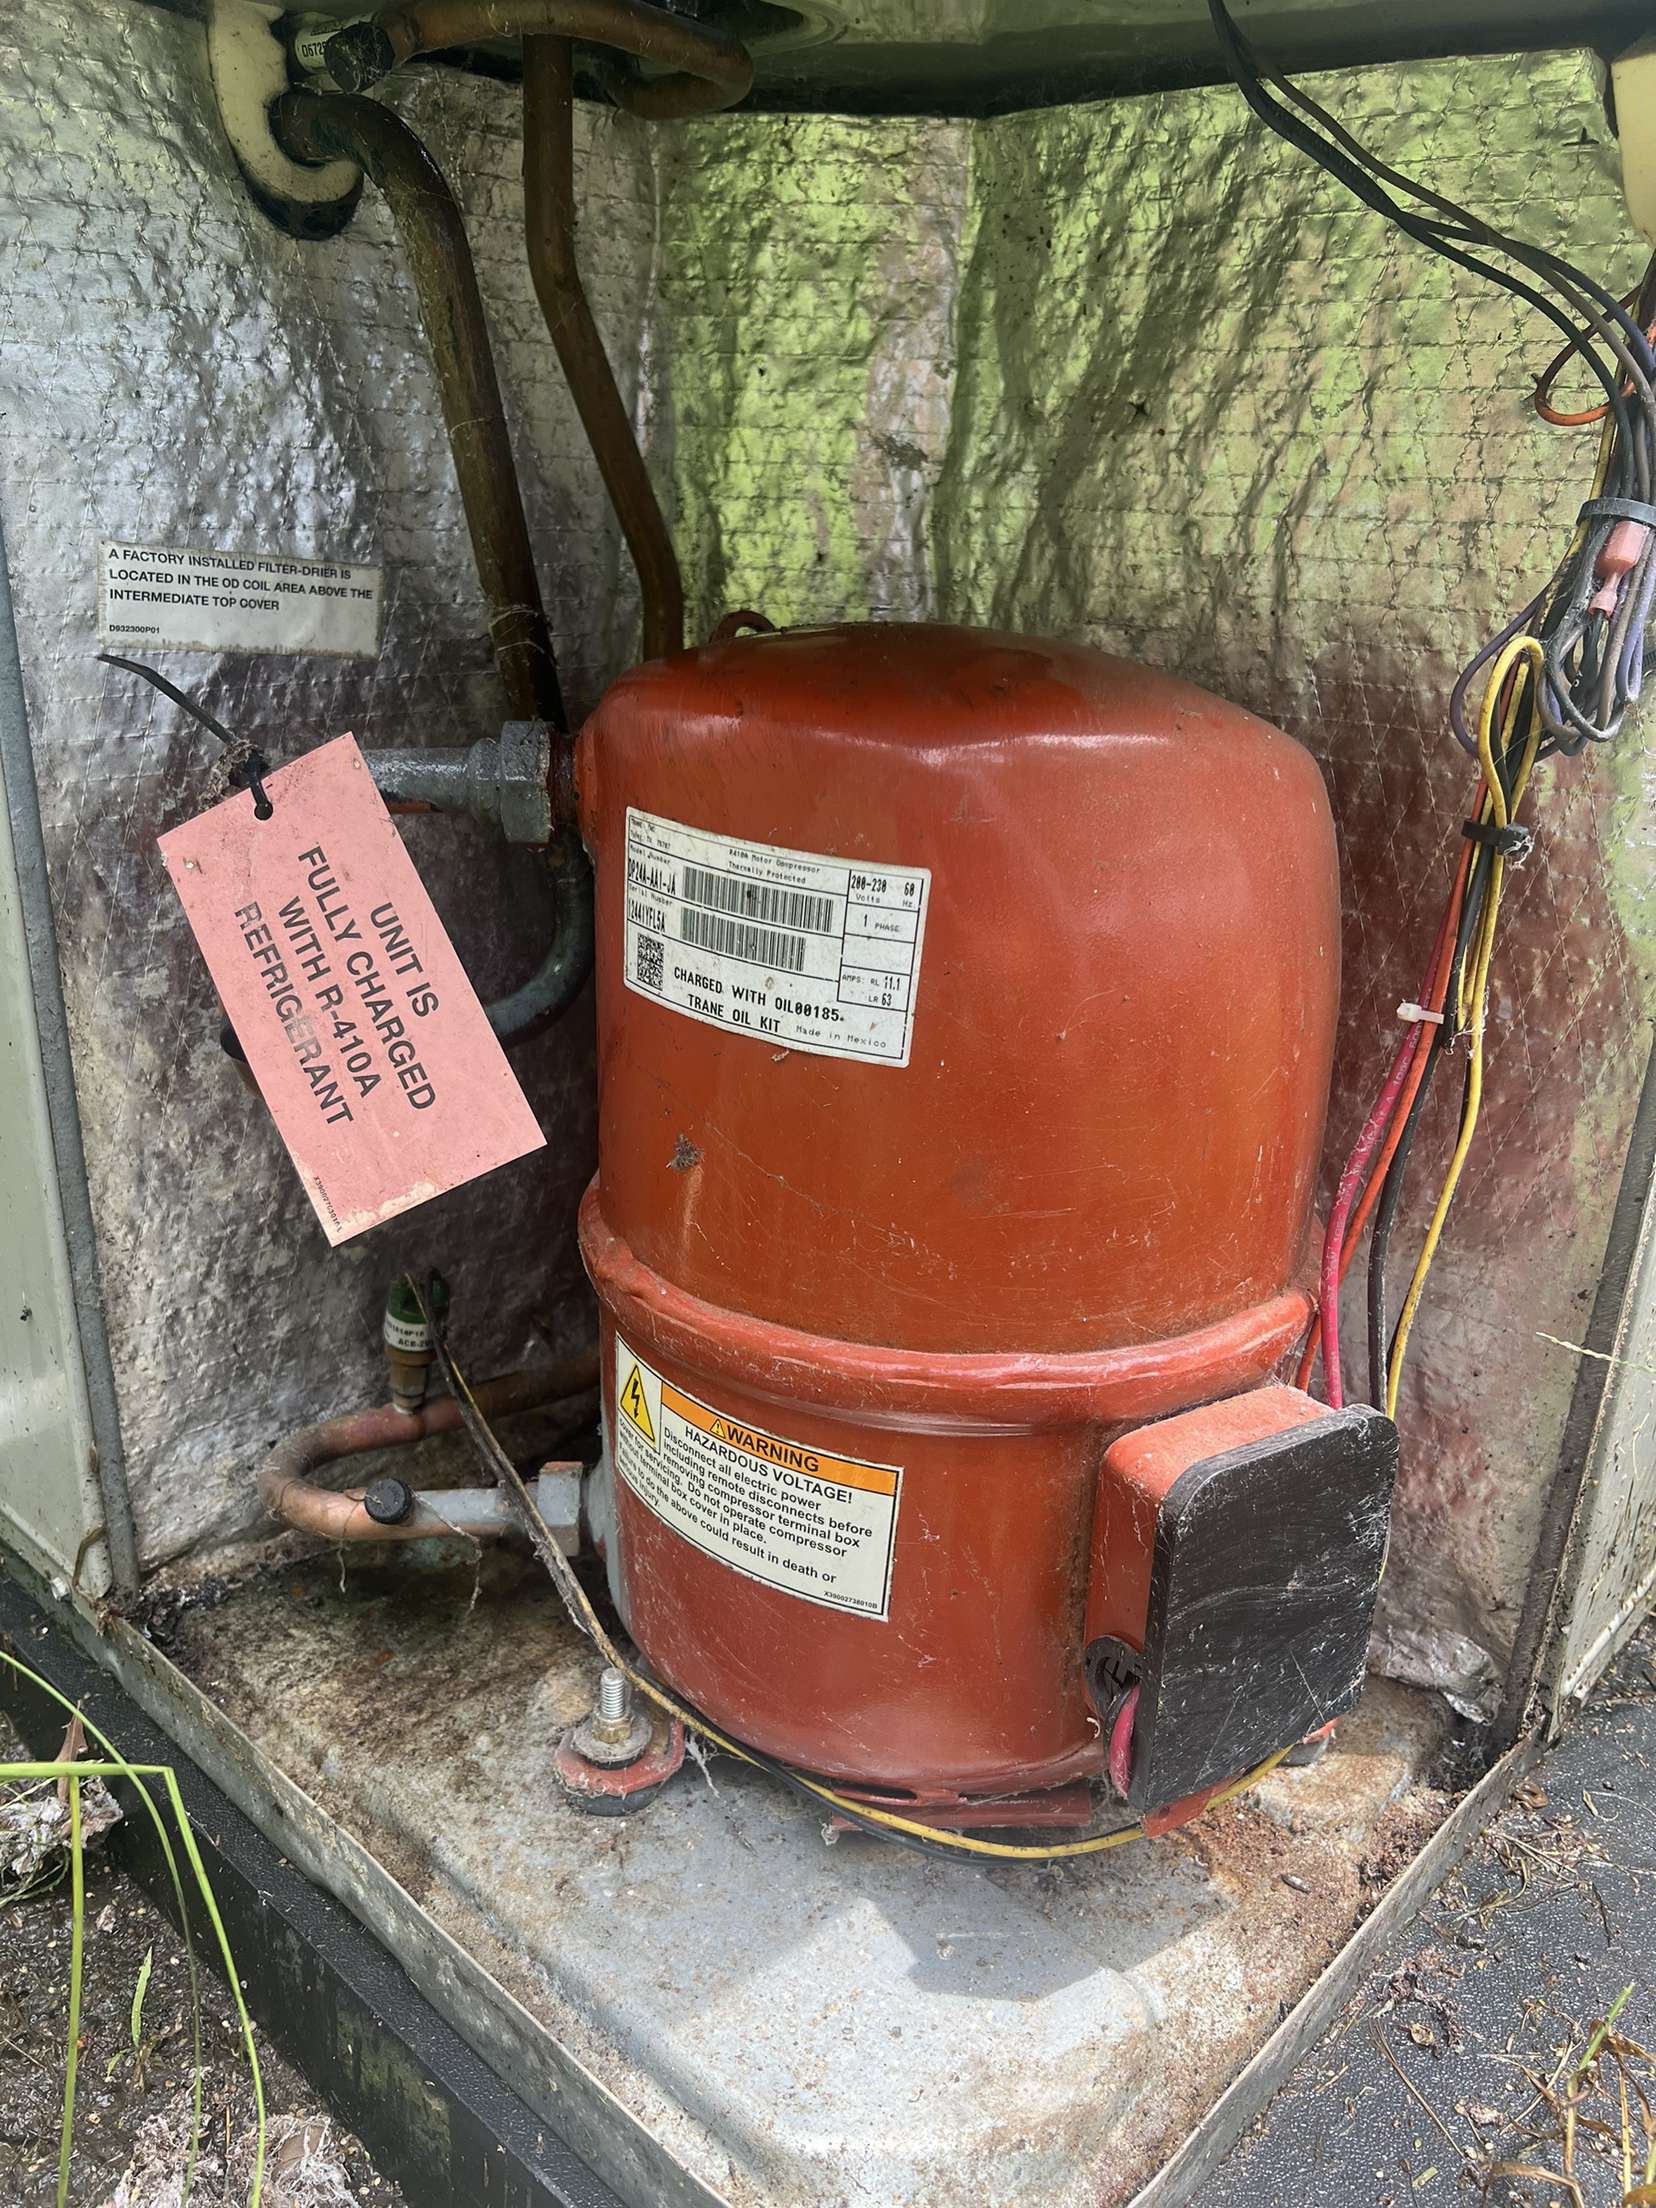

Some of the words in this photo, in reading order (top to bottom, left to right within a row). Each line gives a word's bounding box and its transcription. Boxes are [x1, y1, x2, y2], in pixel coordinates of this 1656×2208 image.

[108, 549, 120, 560] A
[123, 549, 185, 565] FACTORY
[188, 554, 255, 572] INSTALLED
[258, 562, 338, 579] FILTER-DRIER
[340, 568, 351, 580] IS
[109, 569, 174, 585] LOCATED
[177, 573, 191, 585] IN
[194, 575, 219, 588] THE
[222, 577, 240, 589] OD
[243, 579, 270, 592] COIL
[273, 581, 305, 595] AREA
[308, 584, 348, 598] ABOVE
[351, 588, 373, 600] THE
[109, 588, 209, 607] INTERMEDIATE
[212, 595, 236, 608] TOP
[239, 597, 280, 611] COVER
[728, 860, 763, 877] Thermally
[766, 869, 807, 884] Protected
[751, 853, 772, 865] Motor
[776, 858, 821, 874] Compressor
[851, 874, 887, 893] 200-230
[904, 882, 915, 897] 60
[855, 893, 881, 904] Volts
[863, 914, 868, 928] 1
[874, 922, 901, 933] PHASE
[298, 845, 363, 943] FULLY
[346, 951, 437, 1111] CHARGED
[369, 902, 424, 977] UNIT
[406, 982, 440, 1018] IS
[673, 966, 723, 994] CHARGED
[731, 984, 767, 1006] WITH
[234, 900, 354, 1125] REFRIGERANT
[278, 895, 332, 982] WITH
[315, 983, 383, 1098] R-410A
[687, 993, 724, 1018] TRANE
[732, 1008, 751, 1025] OIL
[759, 1015, 780, 1033] KIT
[795, 1024, 822, 1038] Made
[829, 1030, 841, 1041] in
[847, 1034, 887, 1049] Mexico
[881, 993, 893, 1006] 63
[664, 1427, 717, 1468] Disconnect
[719, 1465, 732, 1477] all
[734, 1471, 778, 1497] electric
[781, 1490, 821, 1512] power
[685, 1426, 768, 1477] HAZARDOUS
[772, 1468, 853, 1504] VOLTAGE!
[726, 1424, 820, 1472] WARNING
[634, 1436, 645, 1449] for
[645, 1448, 683, 1487] servicing.
[687, 1481, 701, 1497] Do
[703, 1491, 722, 1509] not
[722, 1503, 766, 1531] operate
[768, 1525, 848, 1558] compressor
[640, 1456, 670, 1488] terminal
[671, 1482, 688, 1502] box
[690, 1497, 718, 1519] cover
[719, 1512, 730, 1526] in
[732, 1520, 767, 1545] place.
[663, 1440, 705, 1477] including
[707, 1470, 746, 1496] remote
[749, 1491, 825, 1526] disconnects
[828, 1517, 873, 1538] before
[663, 1452, 706, 1490] removing
[707, 1484, 776, 1522] compressor
[778, 1513, 831, 1541] terminal
[834, 1530, 861, 1548] box
[637, 1470, 644, 1480] to
[645, 1476, 656, 1491] do
[656, 1486, 669, 1502] the
[670, 1499, 698, 1524] above
[700, 1518, 730, 1542] could
[731, 1535, 765, 1559] result
[767, 1550, 779, 1565] in
[782, 1557, 819, 1579] death
[821, 1572, 837, 1584] or
